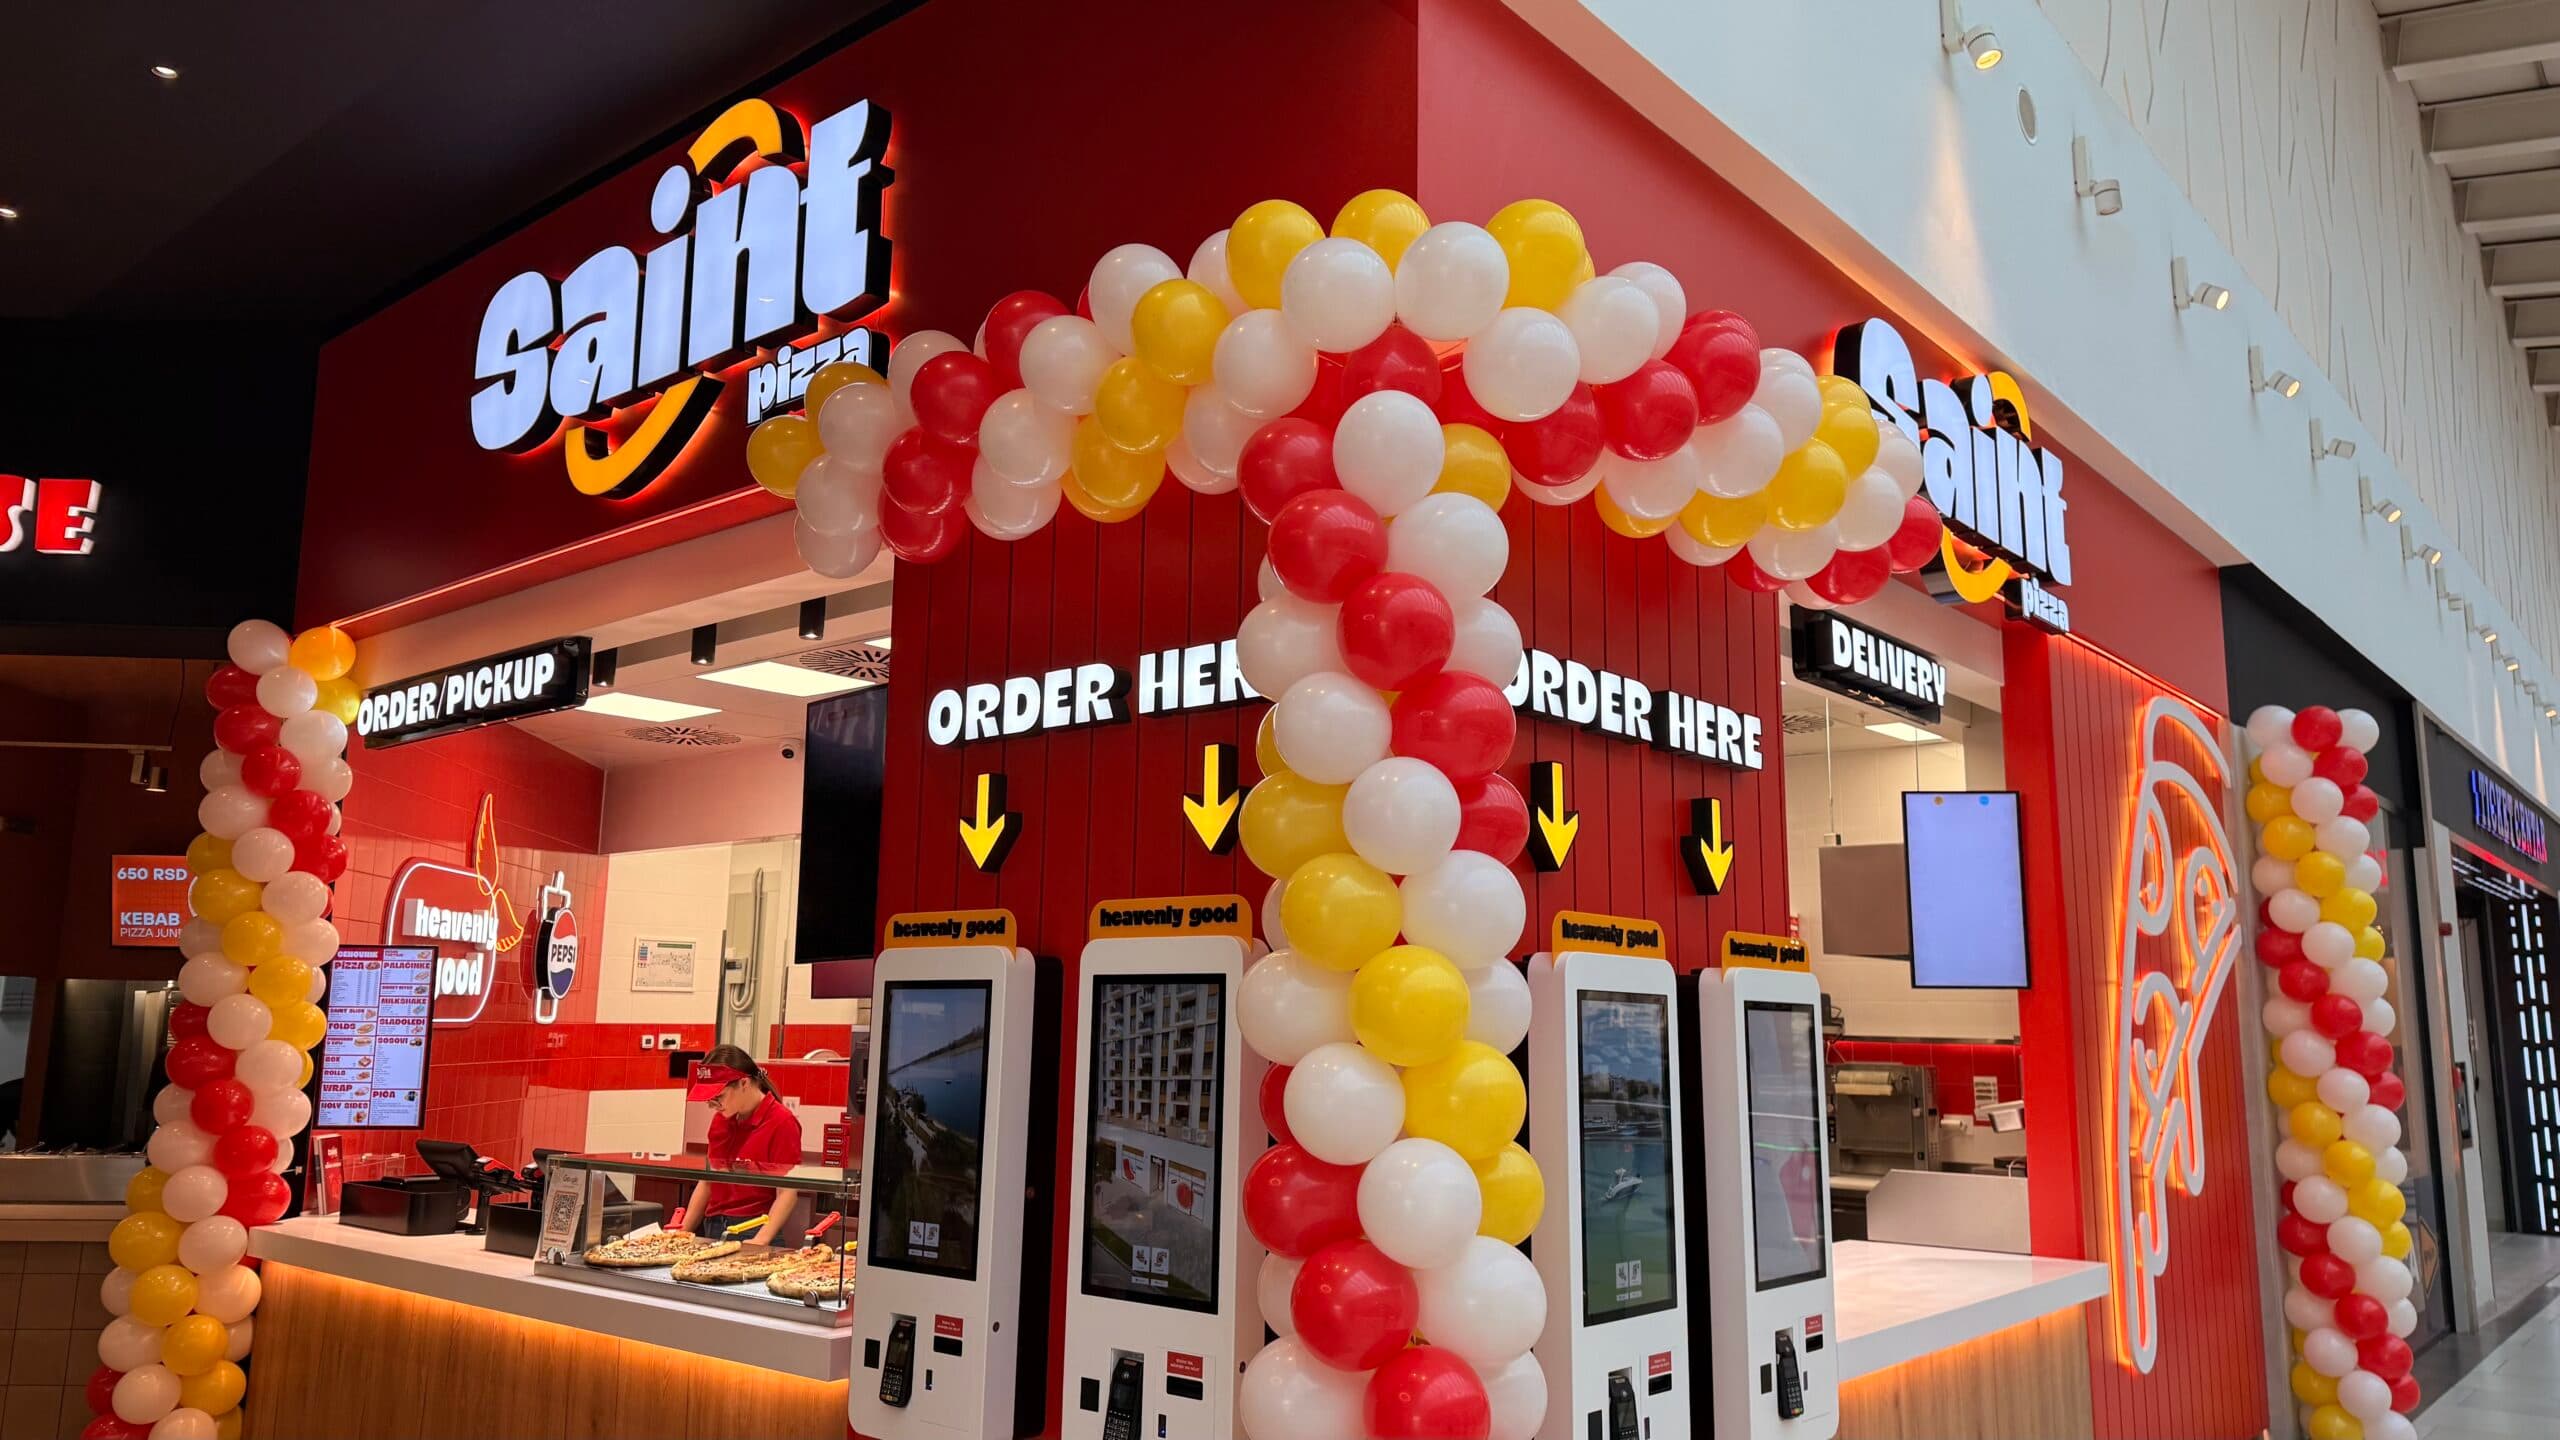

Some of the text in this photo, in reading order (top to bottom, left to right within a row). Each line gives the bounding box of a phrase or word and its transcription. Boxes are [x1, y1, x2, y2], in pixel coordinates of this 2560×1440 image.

[2020, 576, 2070, 633] pizza
[1831, 619, 1946, 707] DELIVERY
[357, 652, 556, 737] ORDER/PICKUP
[927, 638, 1263, 746] ORDER HER
[1502, 649, 1763, 770] ORDER HERE
[117, 867, 188, 881] 650 RSD
[120, 911, 180, 926] KEBAB
[414, 898, 499, 951] heavenly
[892, 916, 1006, 940] heavenly good
[1099, 903, 1238, 928] heavenly good
[120, 927, 154, 938] PIZZA
[1561, 918, 1659, 948] heavenly good
[551, 943, 577, 964] PEPSI
[1729, 938, 1805, 964] heavenly good
[323, 1084, 353, 1092] WRAP
